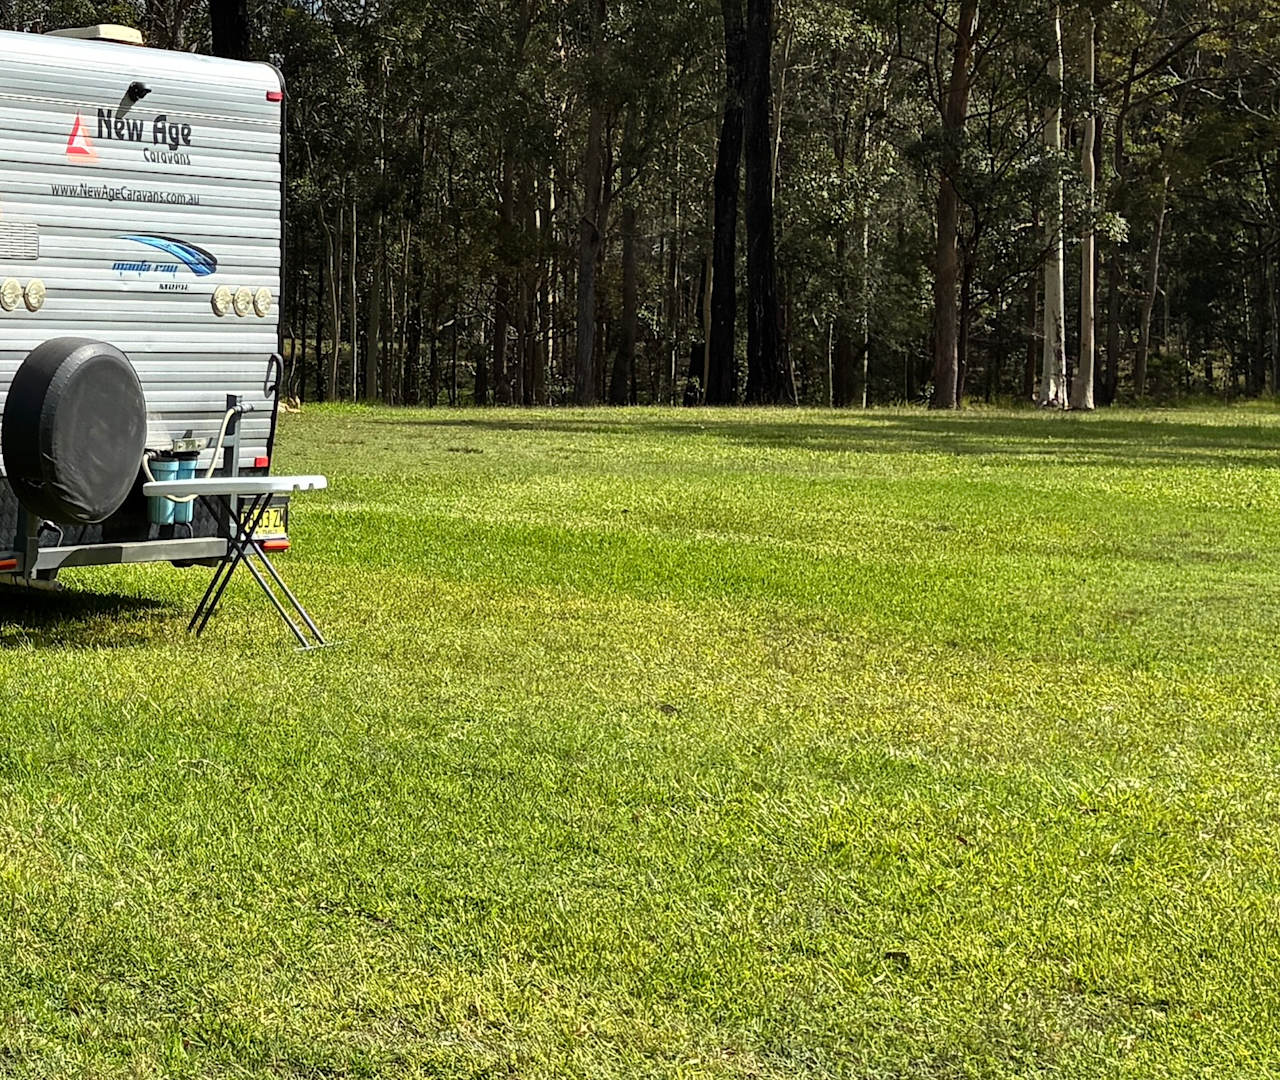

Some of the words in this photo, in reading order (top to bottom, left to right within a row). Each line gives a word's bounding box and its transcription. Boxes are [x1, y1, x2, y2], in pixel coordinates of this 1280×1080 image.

[97, 108, 144, 142] New
[152, 114, 192, 151] Age
[143, 147, 191, 166] Caravans
[50, 182, 200, 205] www.NewAgeCaravans.com.au
